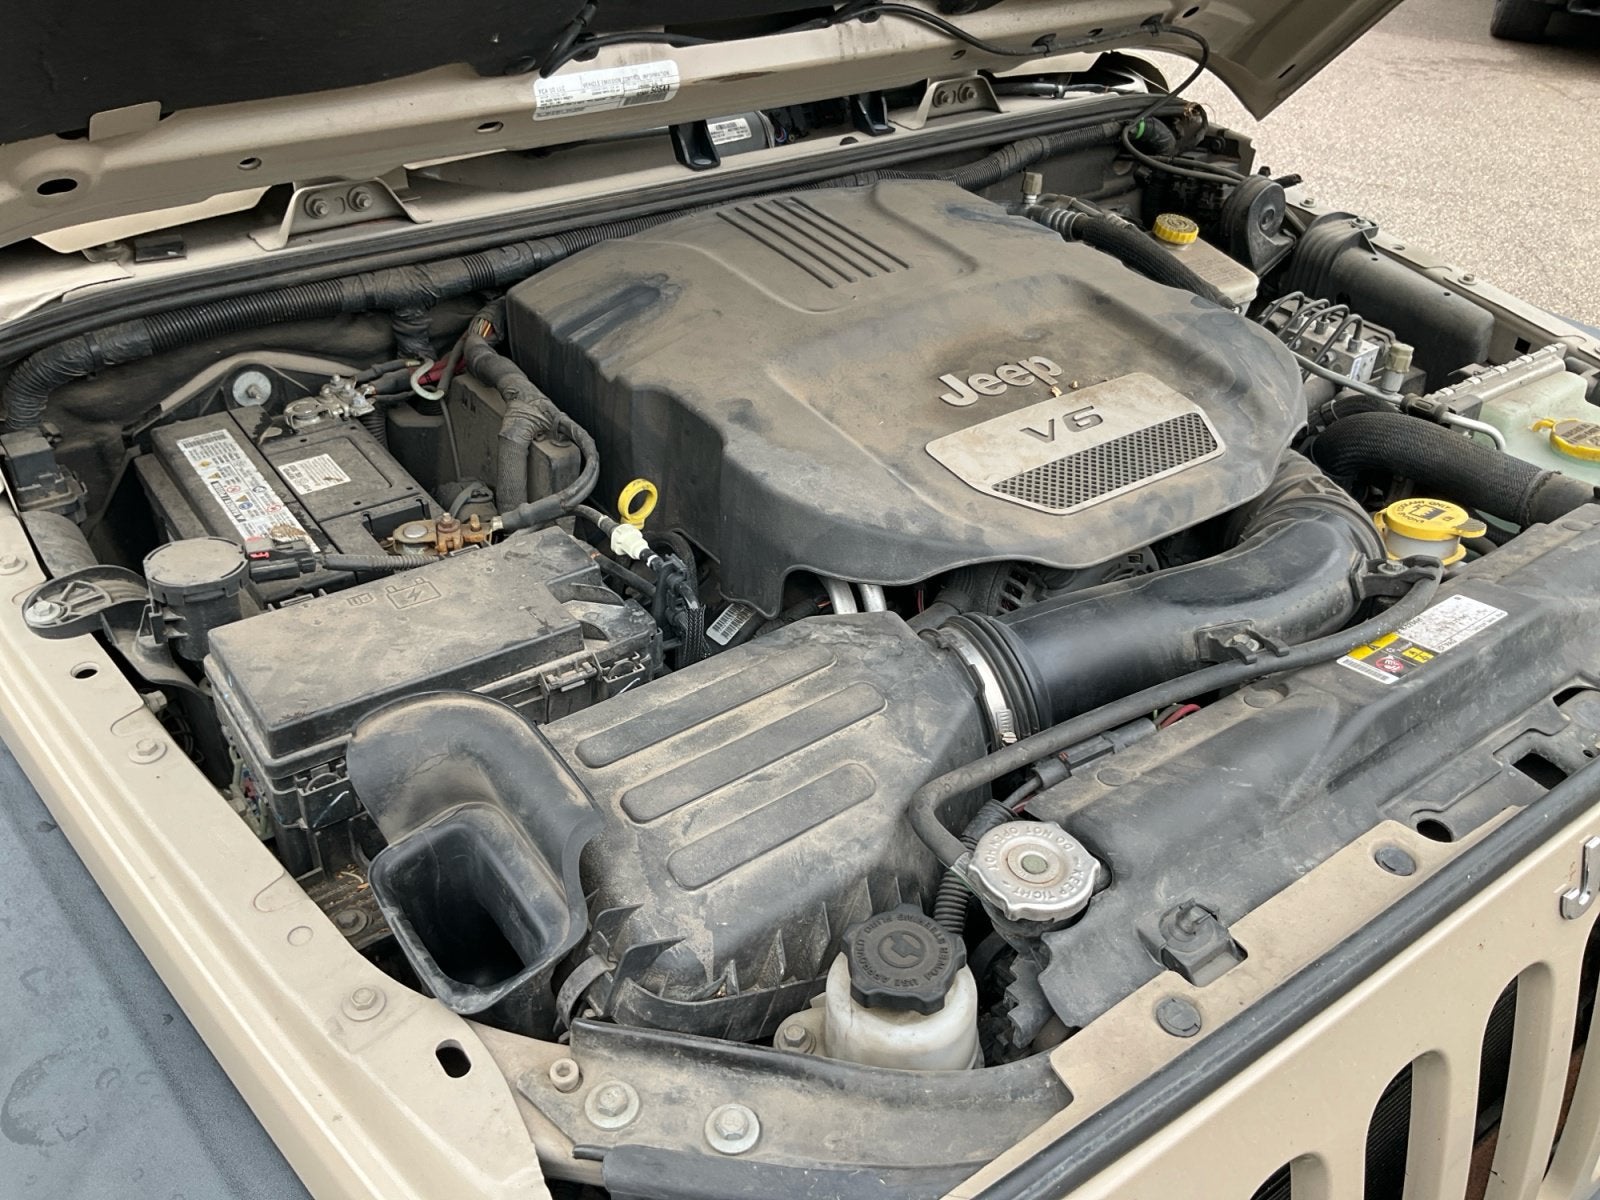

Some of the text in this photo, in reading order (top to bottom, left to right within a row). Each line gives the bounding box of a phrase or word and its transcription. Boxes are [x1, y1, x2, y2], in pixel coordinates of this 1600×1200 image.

[938, 355, 1063, 407] Jeep
[1019, 405, 1104, 444] V6
[989, 826, 1019, 848] OPEN
[1025, 825, 1053, 839] NOT
[1056, 836, 1075, 852] DO
[984, 848, 1001, 871] HOT
[1013, 868, 1085, 901] KEEP TIGHT
